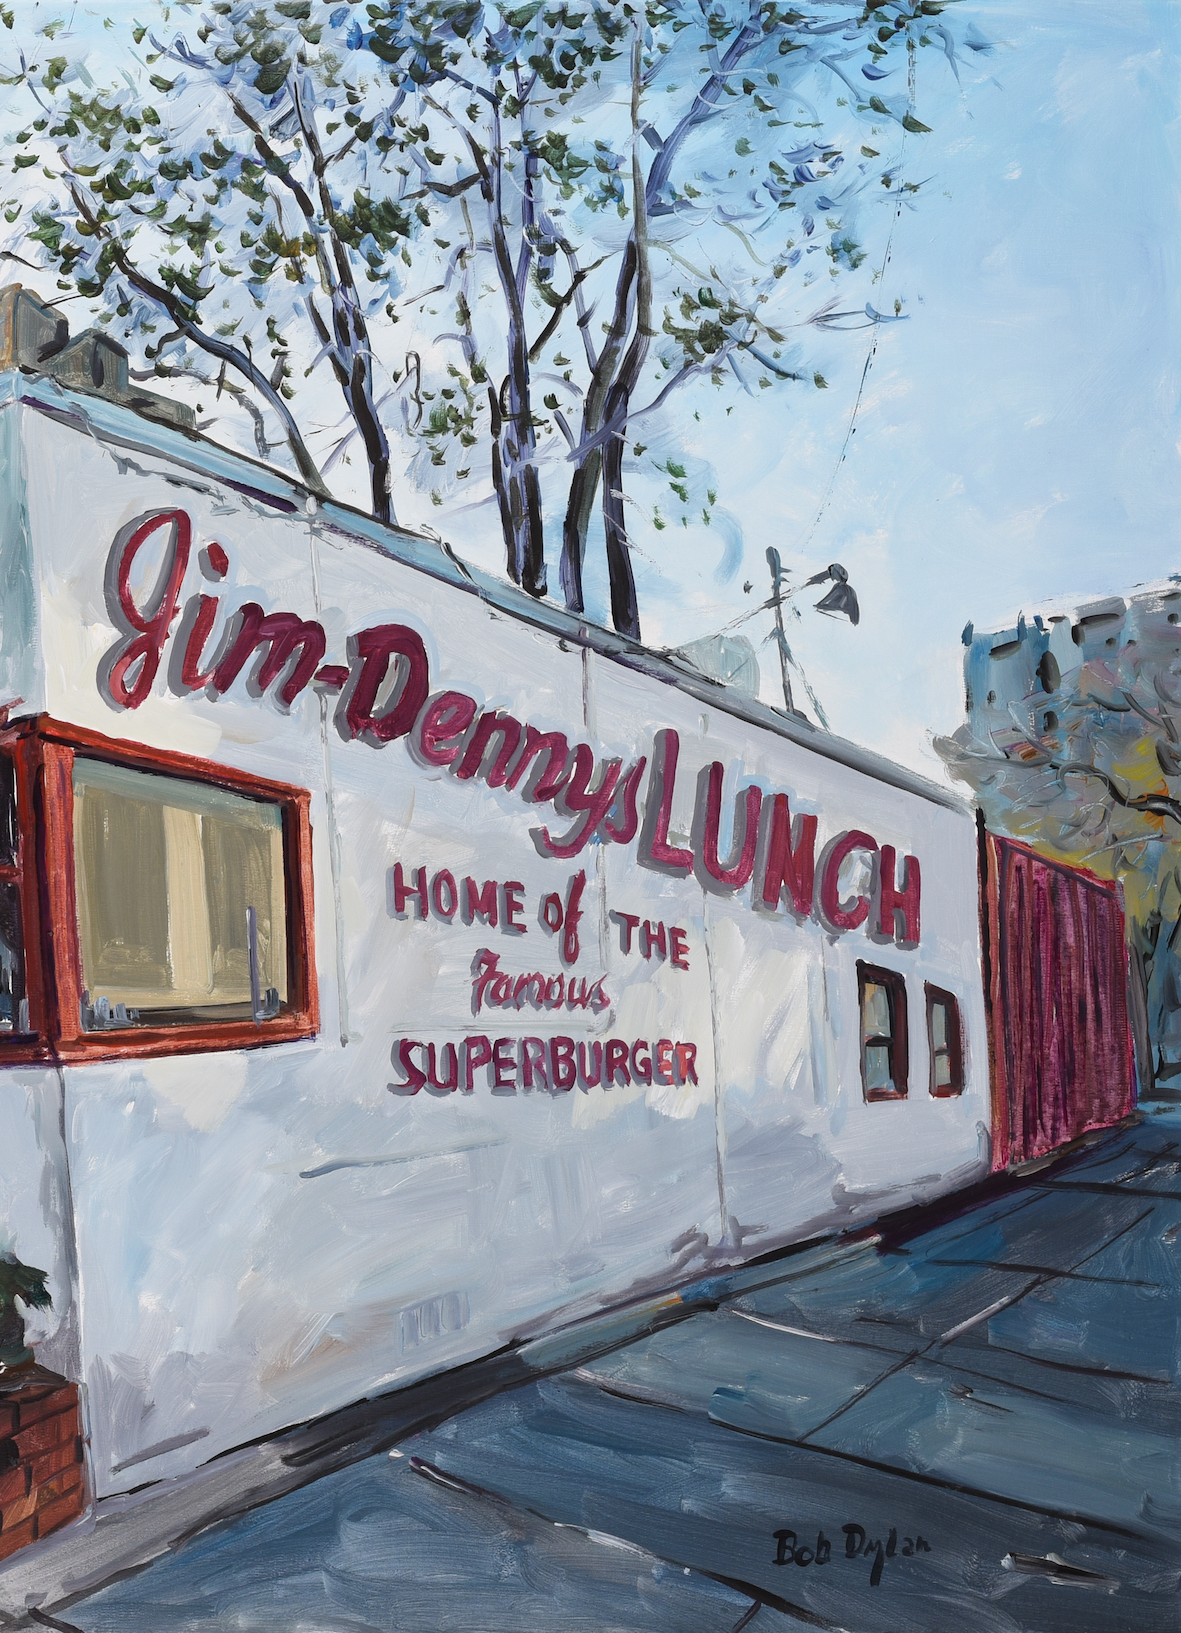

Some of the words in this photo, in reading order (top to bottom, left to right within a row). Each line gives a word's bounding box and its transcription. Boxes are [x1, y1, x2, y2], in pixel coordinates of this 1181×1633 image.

[641, 727, 921, 948] LUNCH
[389, 862, 527, 934] HOME
[540, 869, 587, 966] of
[610, 909, 690, 971] THE
[470, 947, 611, 1016] Famous
[387, 1035, 699, 1096] SUPERBURGER
[772, 1529, 831, 1567] Bob
[842, 1523, 931, 1587] Dylan
